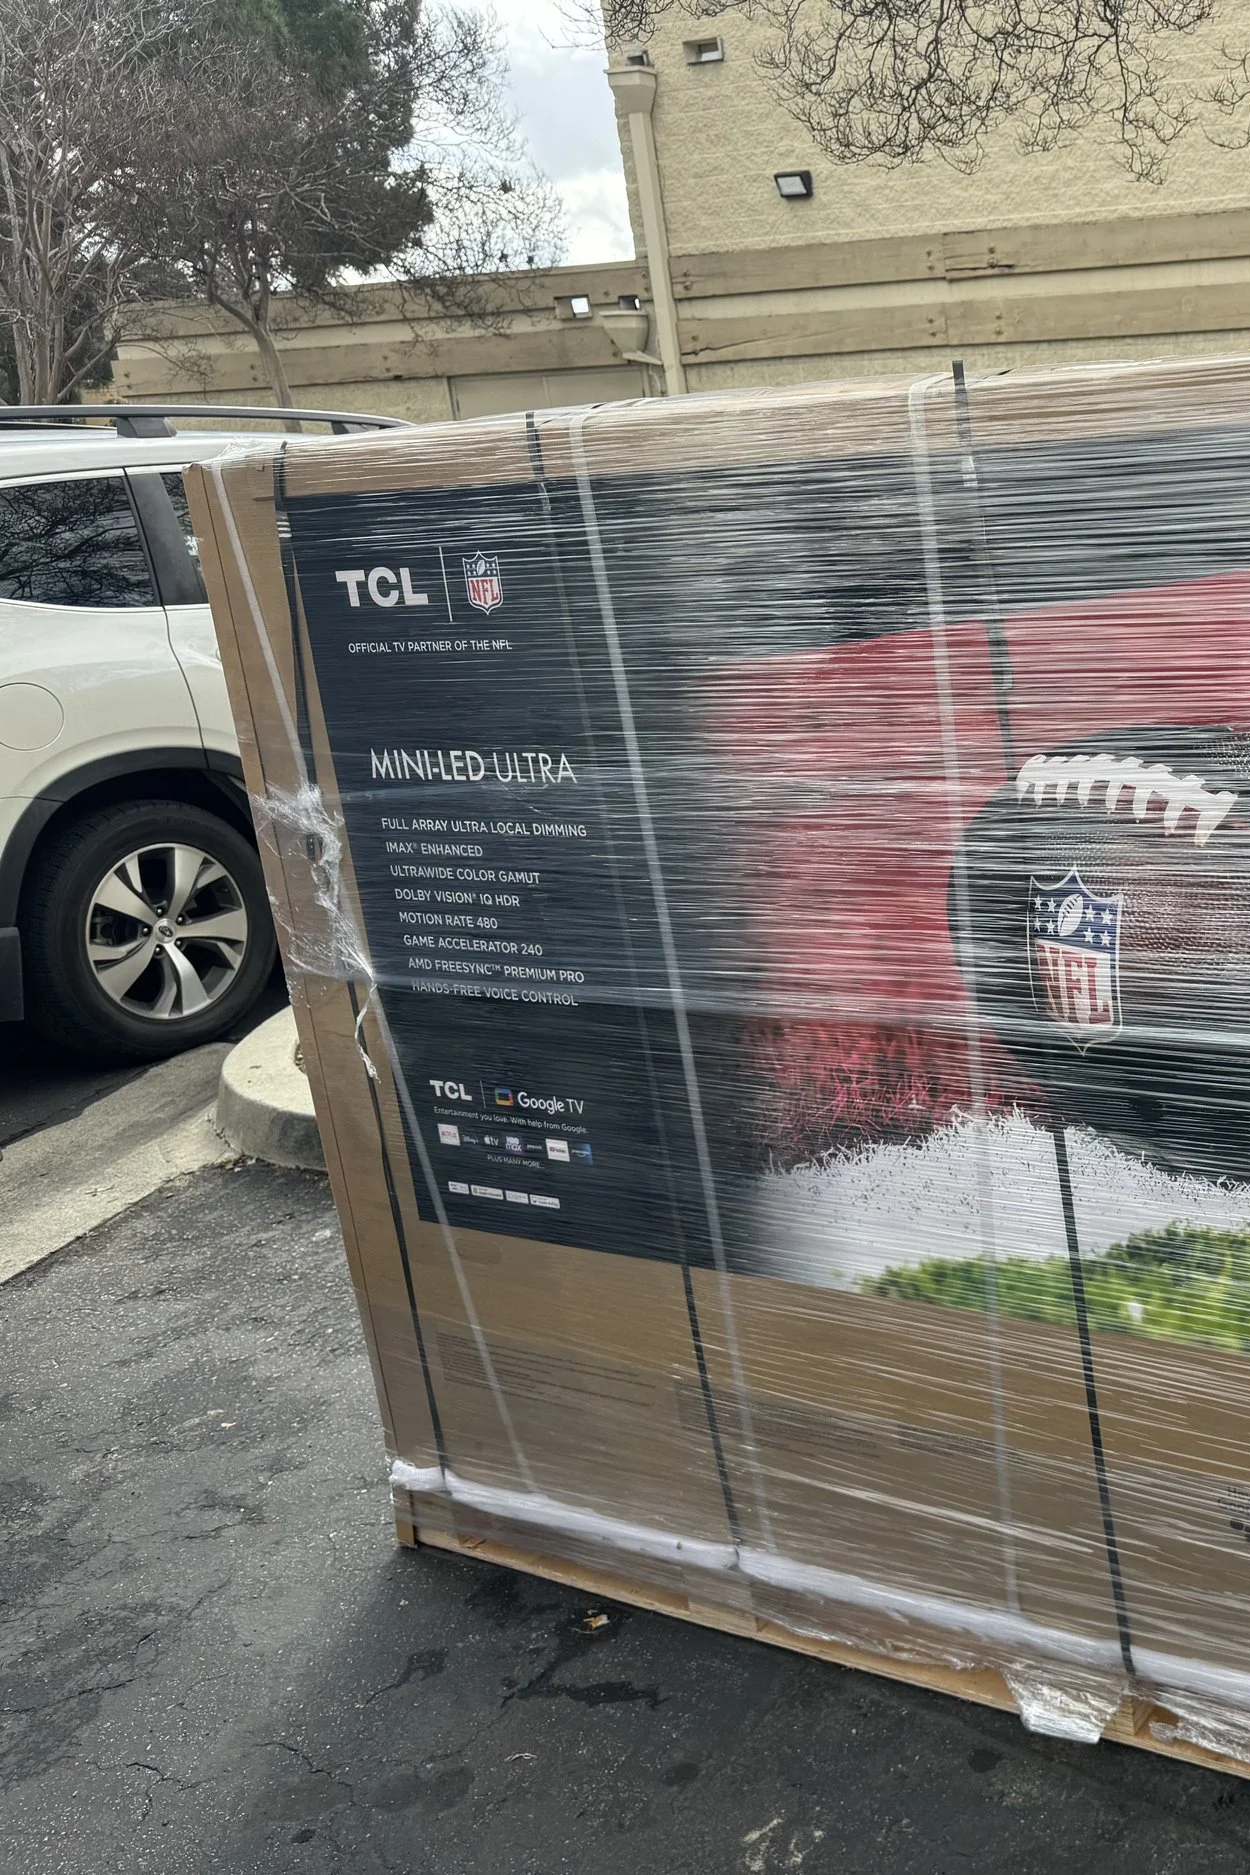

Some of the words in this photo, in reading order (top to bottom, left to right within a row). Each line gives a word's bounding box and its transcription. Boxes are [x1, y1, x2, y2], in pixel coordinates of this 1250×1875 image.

[335, 566, 429, 608] TCL
[470, 578, 499, 605] NFL
[348, 642, 391, 653] OFFICIAL
[393, 641, 406, 652] TV
[408, 640, 452, 652] PARTNER
[454, 640, 468, 650] OF
[470, 639, 490, 650] THE
[492, 639, 512, 650] NFL
[371, 748, 485, 781] MINI-LED
[493, 752, 578, 784] ULTRA
[381, 817, 409, 830] FULL
[412, 819, 448, 832] ARRAY
[451, 820, 488, 833] ULTRA
[490, 822, 530, 835] LOCAL
[533, 823, 587, 837] DIMMING
[421, 843, 483, 857] ENHANCED
[390, 865, 454, 879] ULTRAWIDE
[456, 868, 496, 882] COLOR
[499, 870, 540, 884] GAMUT
[395, 888, 431, 901] DOLBY
[479, 893, 493, 905] IQ
[495, 894, 520, 907] HDR
[399, 911, 443, 925] MOTION
[445, 914, 474, 928] RATE
[476, 916, 498, 929] 480
[403, 934, 435, 948] GAME
[438, 937, 519, 954] ACCELERATOR
[521, 943, 543, 956] 240
[408, 957, 433, 970] AMD
[503, 965, 557, 981] PREMIUM
[559, 970, 585, 983] PRO
[412, 980, 482, 997] HANDS-FREE
[484, 986, 519, 1001] VOICE
[521, 990, 579, 1006] CONTROL
[1036, 943, 1113, 1024] NFL
[429, 1080, 472, 1101] TCL
[517, 1091, 565, 1115] Google
[566, 1098, 584, 1115] TV
[433, 1106, 478, 1119] Entertainment
[480, 1112, 492, 1121] you
[509, 1116, 526, 1126] With
[527, 1119, 542, 1129] help
[543, 1120, 560, 1130] from
[561, 1123, 589, 1134] Google.
